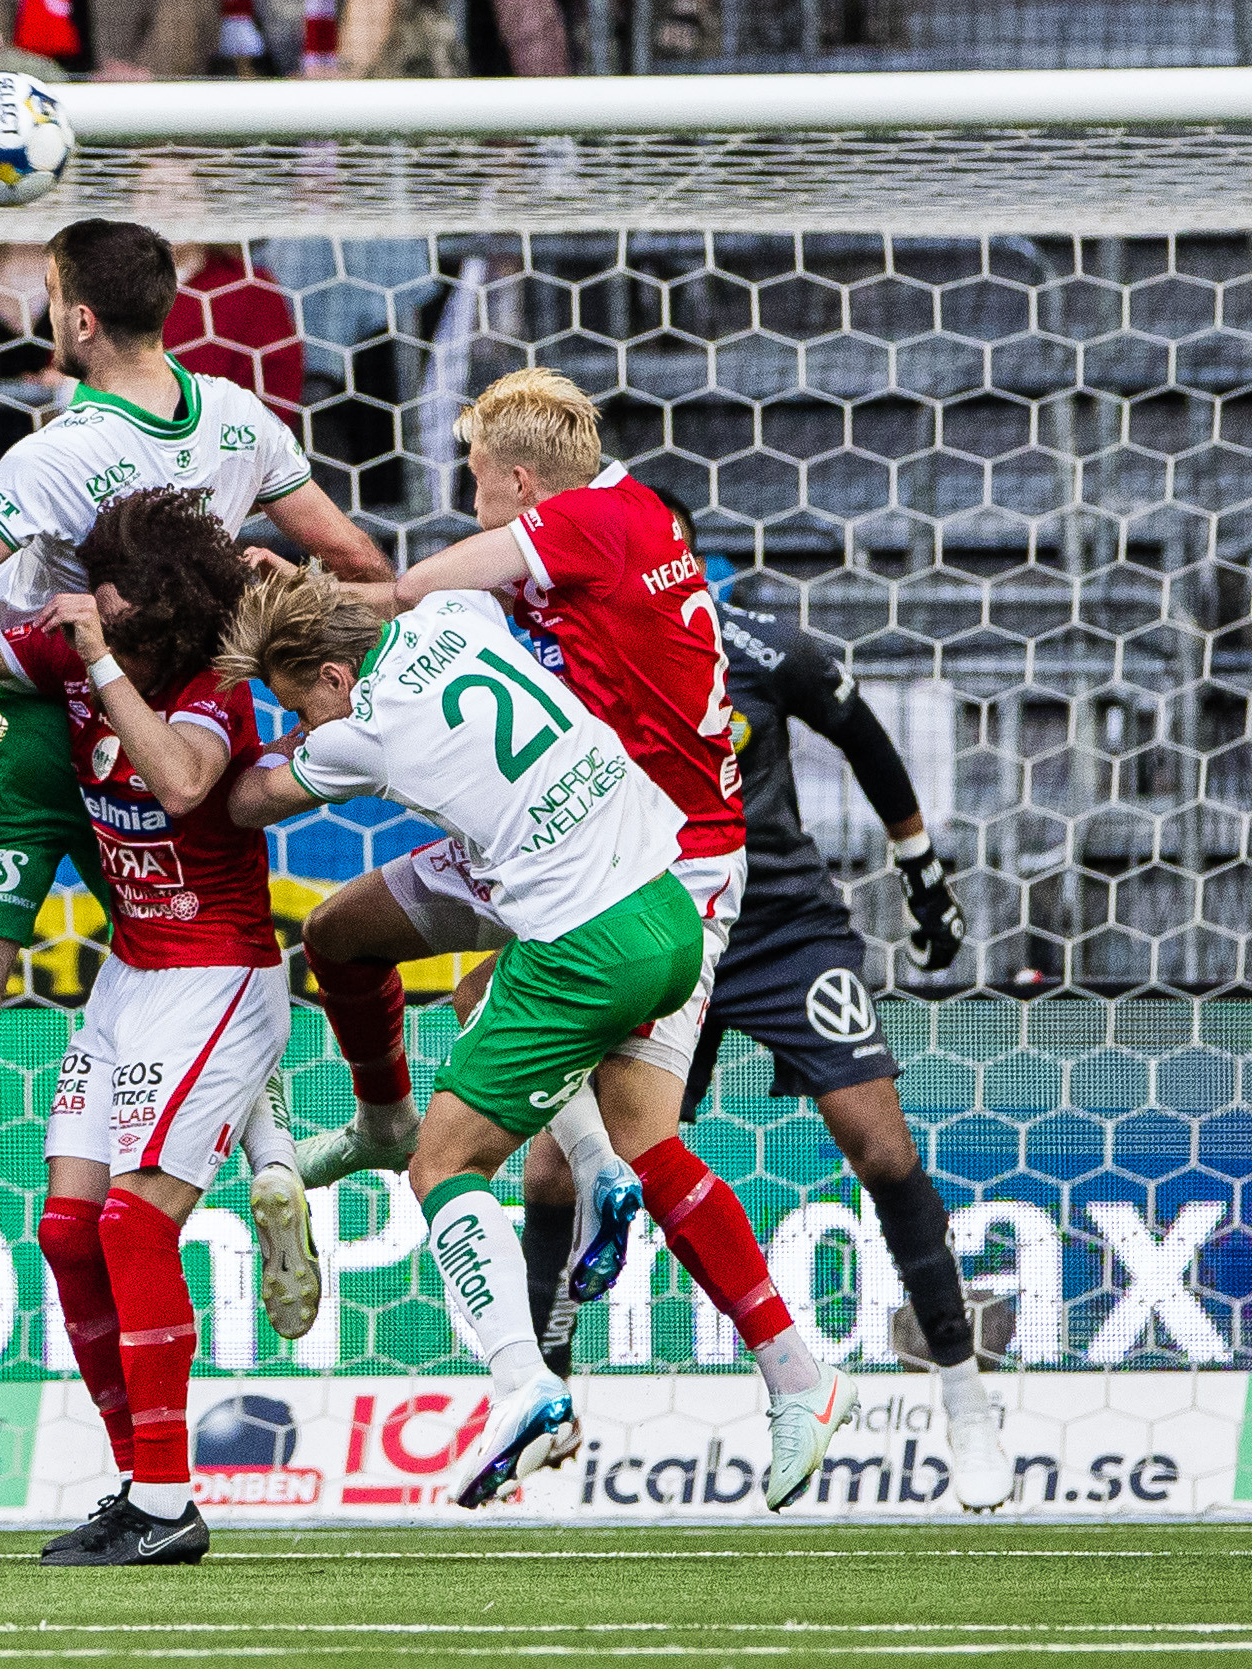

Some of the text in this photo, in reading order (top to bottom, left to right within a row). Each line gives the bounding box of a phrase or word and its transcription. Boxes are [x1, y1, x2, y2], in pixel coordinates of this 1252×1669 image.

[398, 629, 467, 694] STRAND
[442, 647, 574, 784] 21
[80, 787, 168, 831] elmia
[528, 746, 605, 824] NORDIC
[436, 1214, 495, 1315] Clinton
[191, 1470, 318, 1503] OMBEN
[582, 1438, 1180, 1504] icabmbn.se
